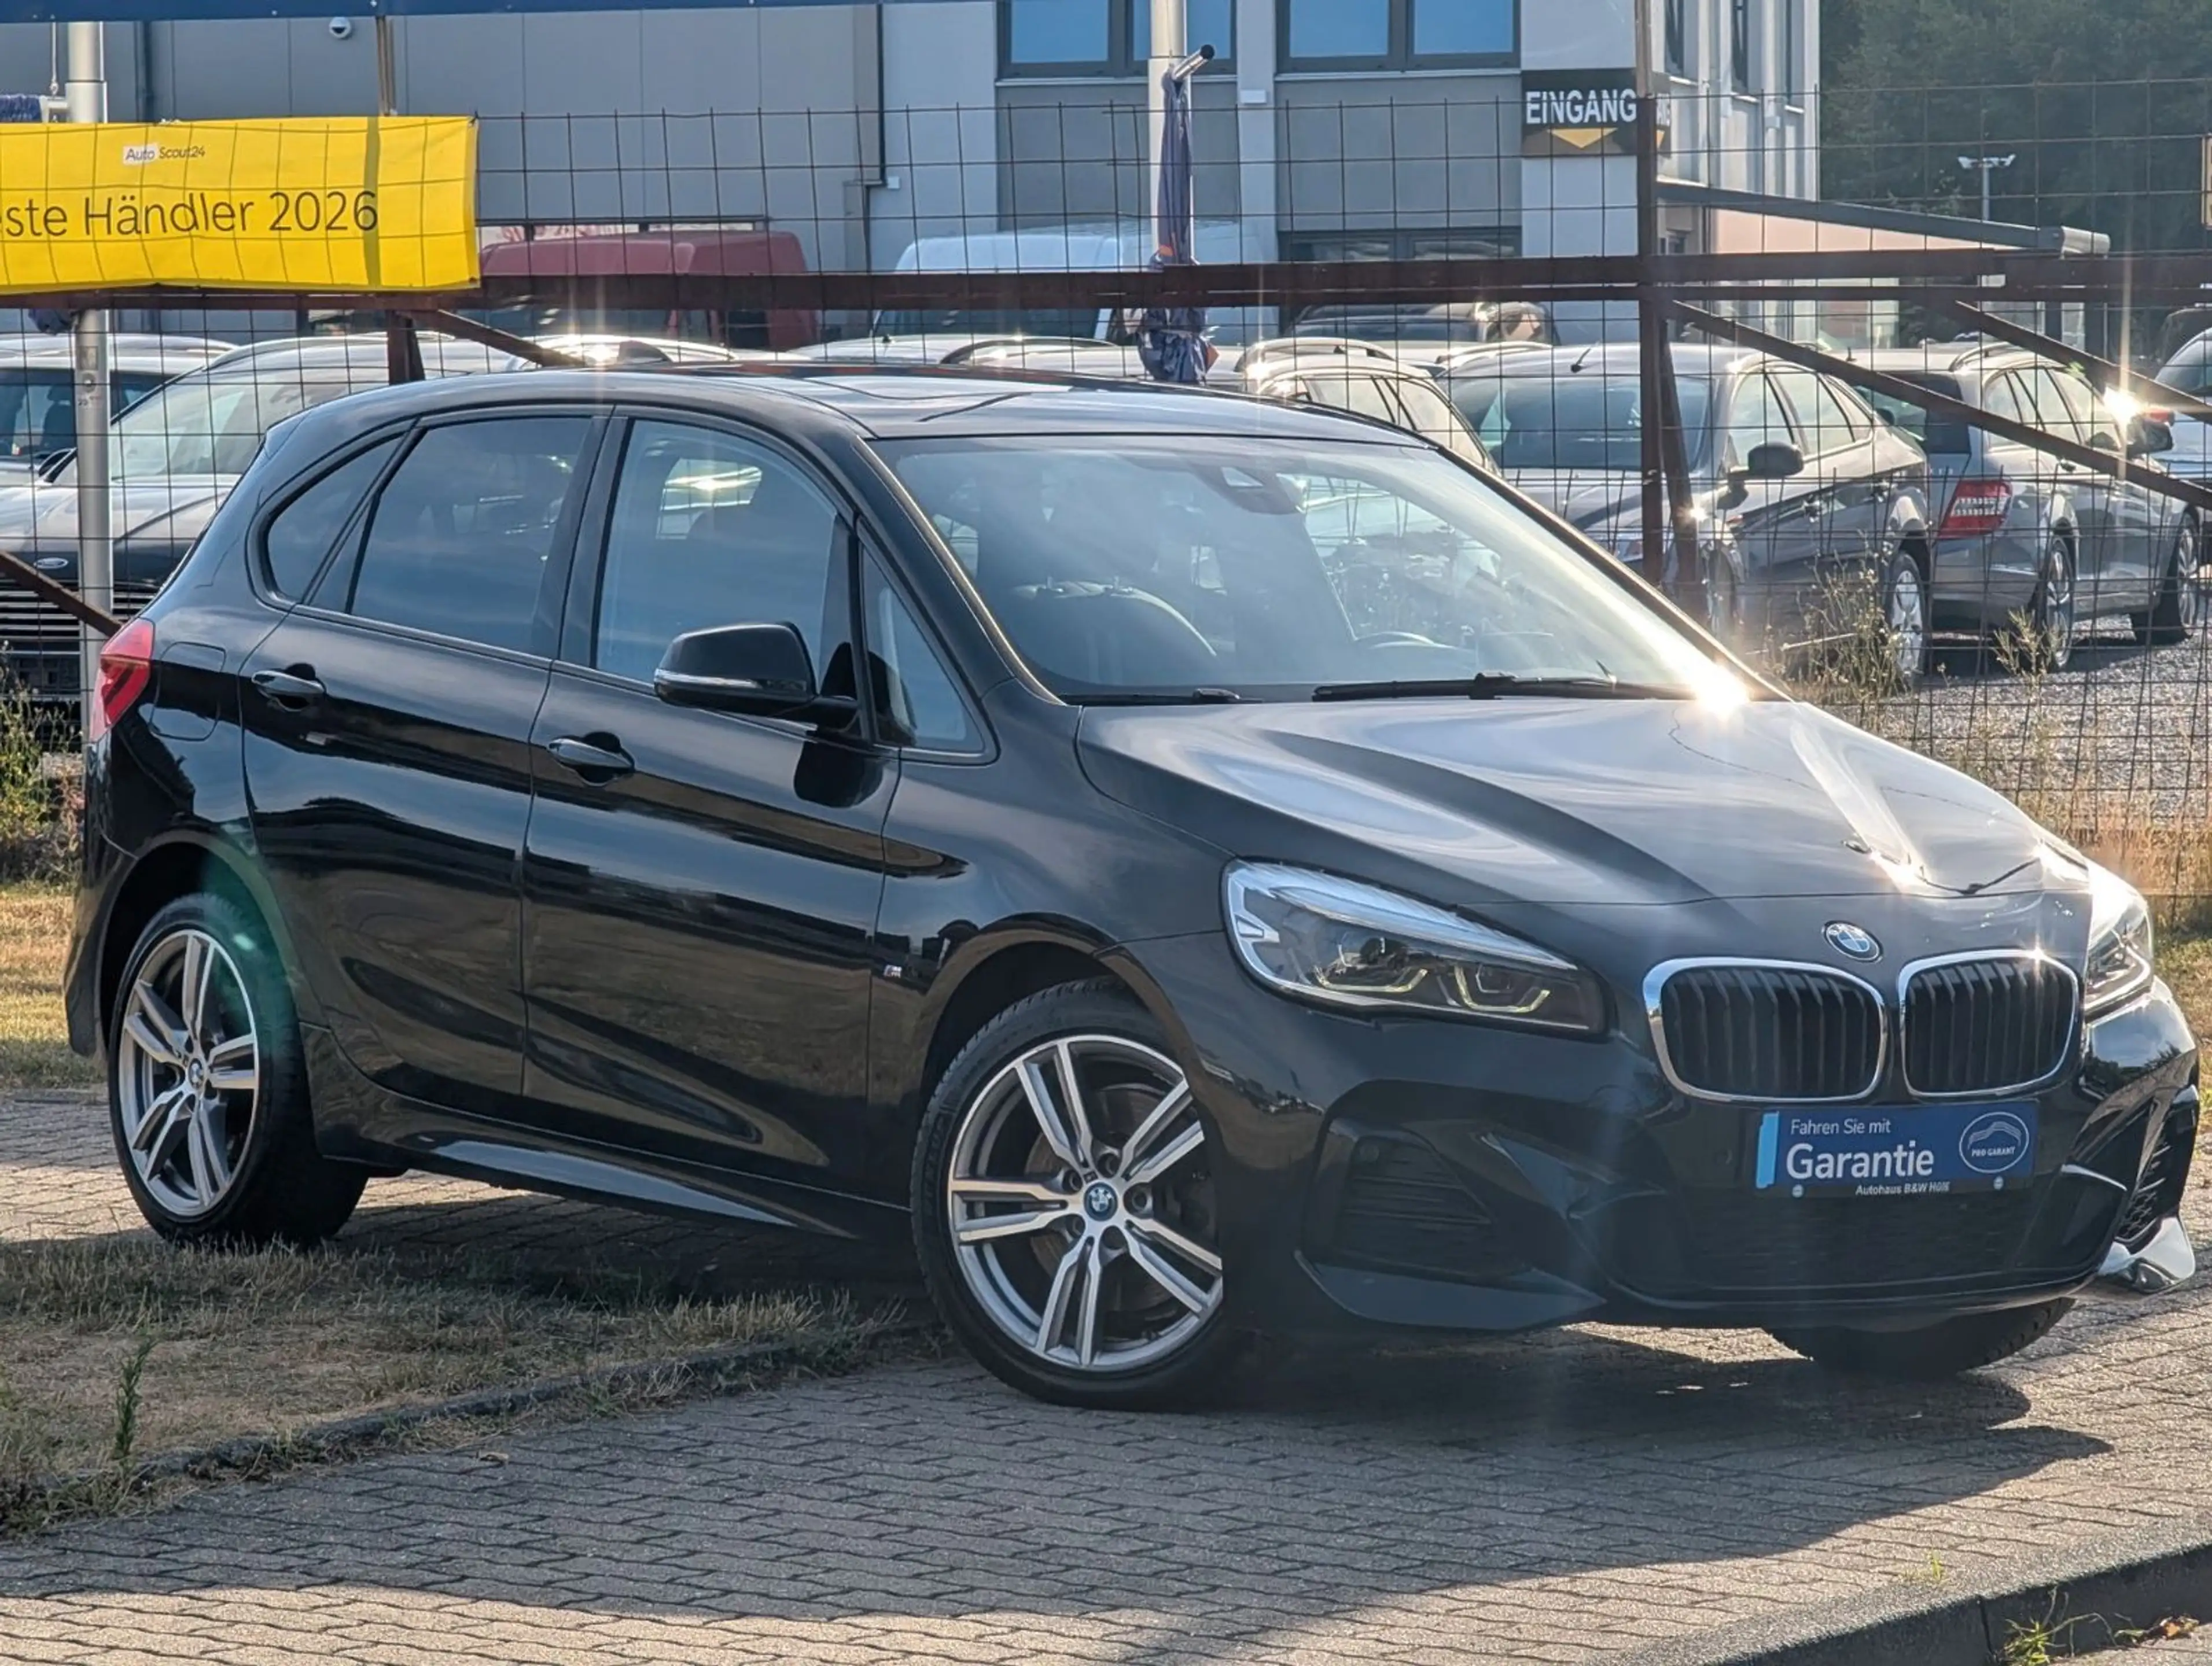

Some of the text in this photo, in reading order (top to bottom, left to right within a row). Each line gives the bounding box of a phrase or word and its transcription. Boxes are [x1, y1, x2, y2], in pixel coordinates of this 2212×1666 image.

[1525, 89, 1637, 124] EINGANG
[126, 145, 205, 161] Auto Scout24
[0, 190, 378, 237] ste Händler 2026
[1791, 1118, 1891, 1135] Fahren Sie mit
[1786, 1140, 1935, 1180] Garantie
[1854, 1184, 1902, 1196] Autohaus
[1904, 1182, 1927, 1193] B&W
